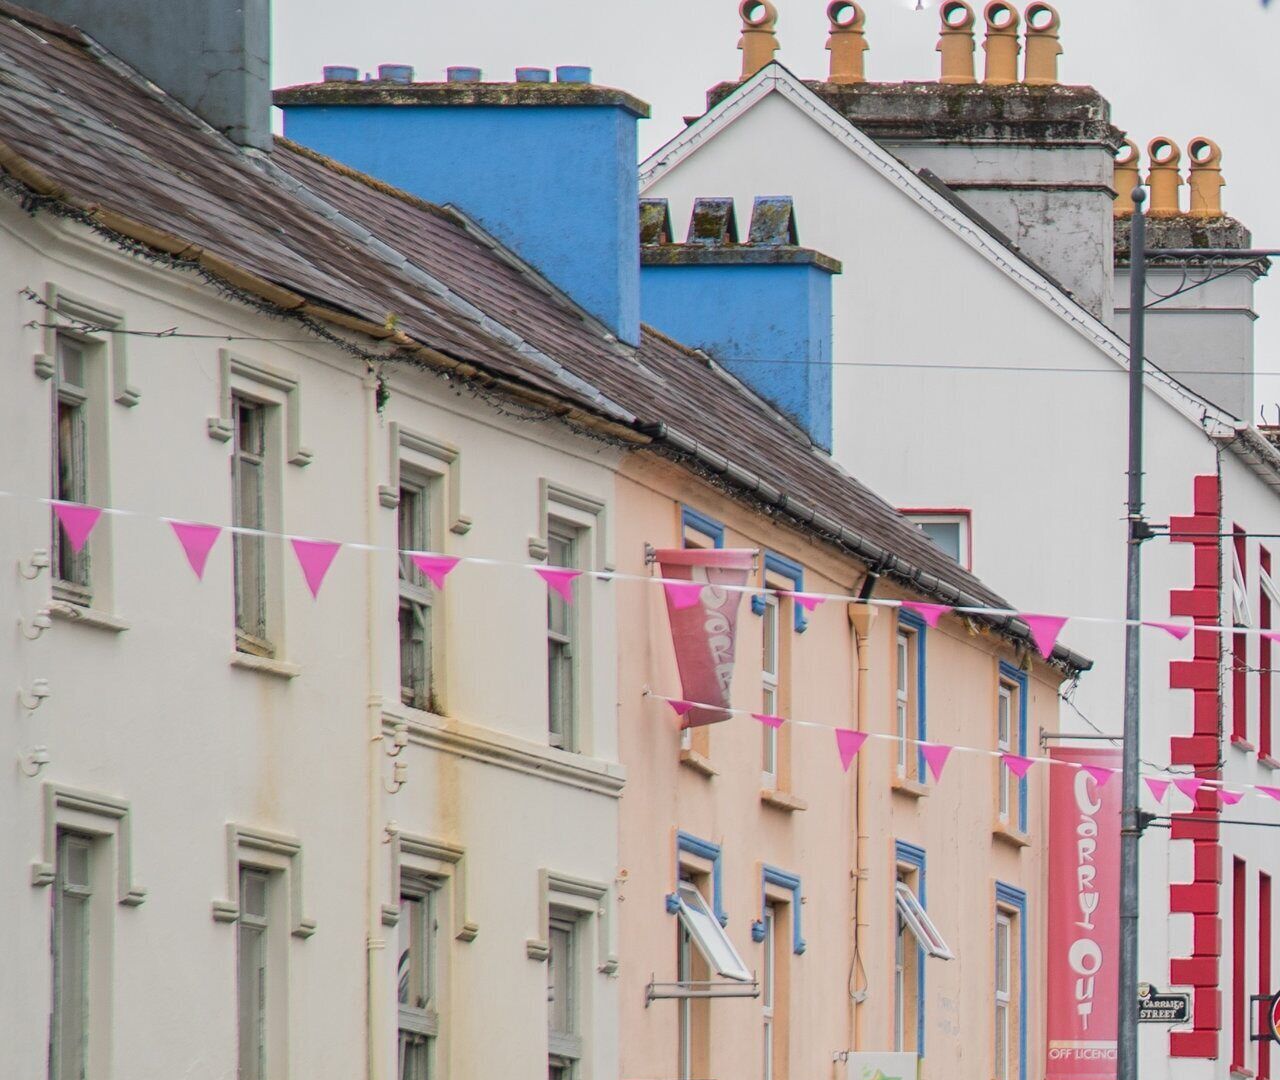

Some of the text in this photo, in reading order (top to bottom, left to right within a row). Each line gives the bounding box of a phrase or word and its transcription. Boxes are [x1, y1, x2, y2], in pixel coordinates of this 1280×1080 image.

[1140, 1010, 1178, 1019] STREET
[1050, 1049, 1117, 1060] OFF LICENC
